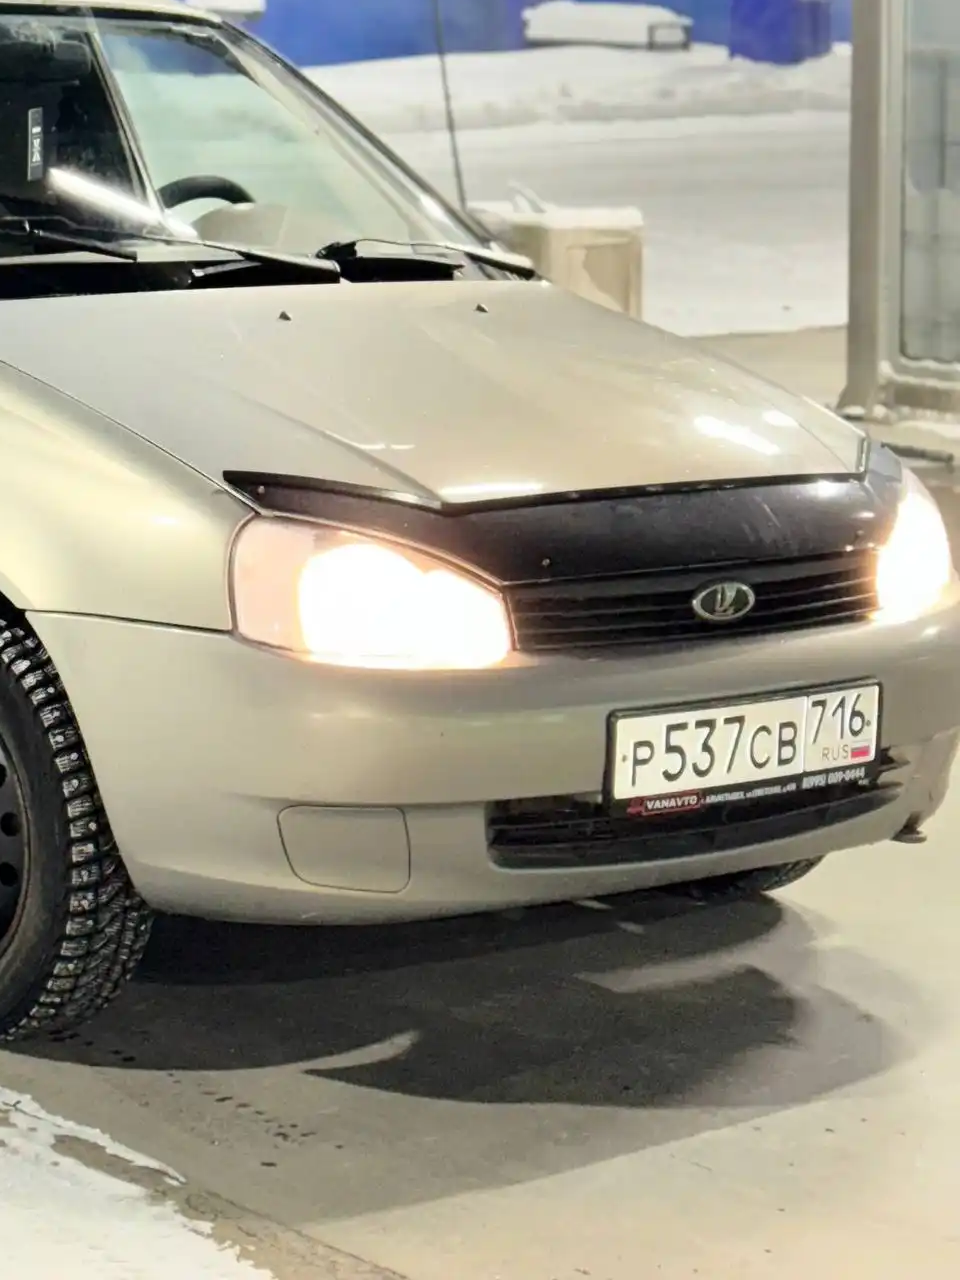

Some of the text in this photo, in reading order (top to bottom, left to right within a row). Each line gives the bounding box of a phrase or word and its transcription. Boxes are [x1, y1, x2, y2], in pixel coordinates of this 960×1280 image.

[811, 693, 866, 745] 716
[822, 744, 849, 761] RUS
[645, 795, 698, 810] VANAVTO
